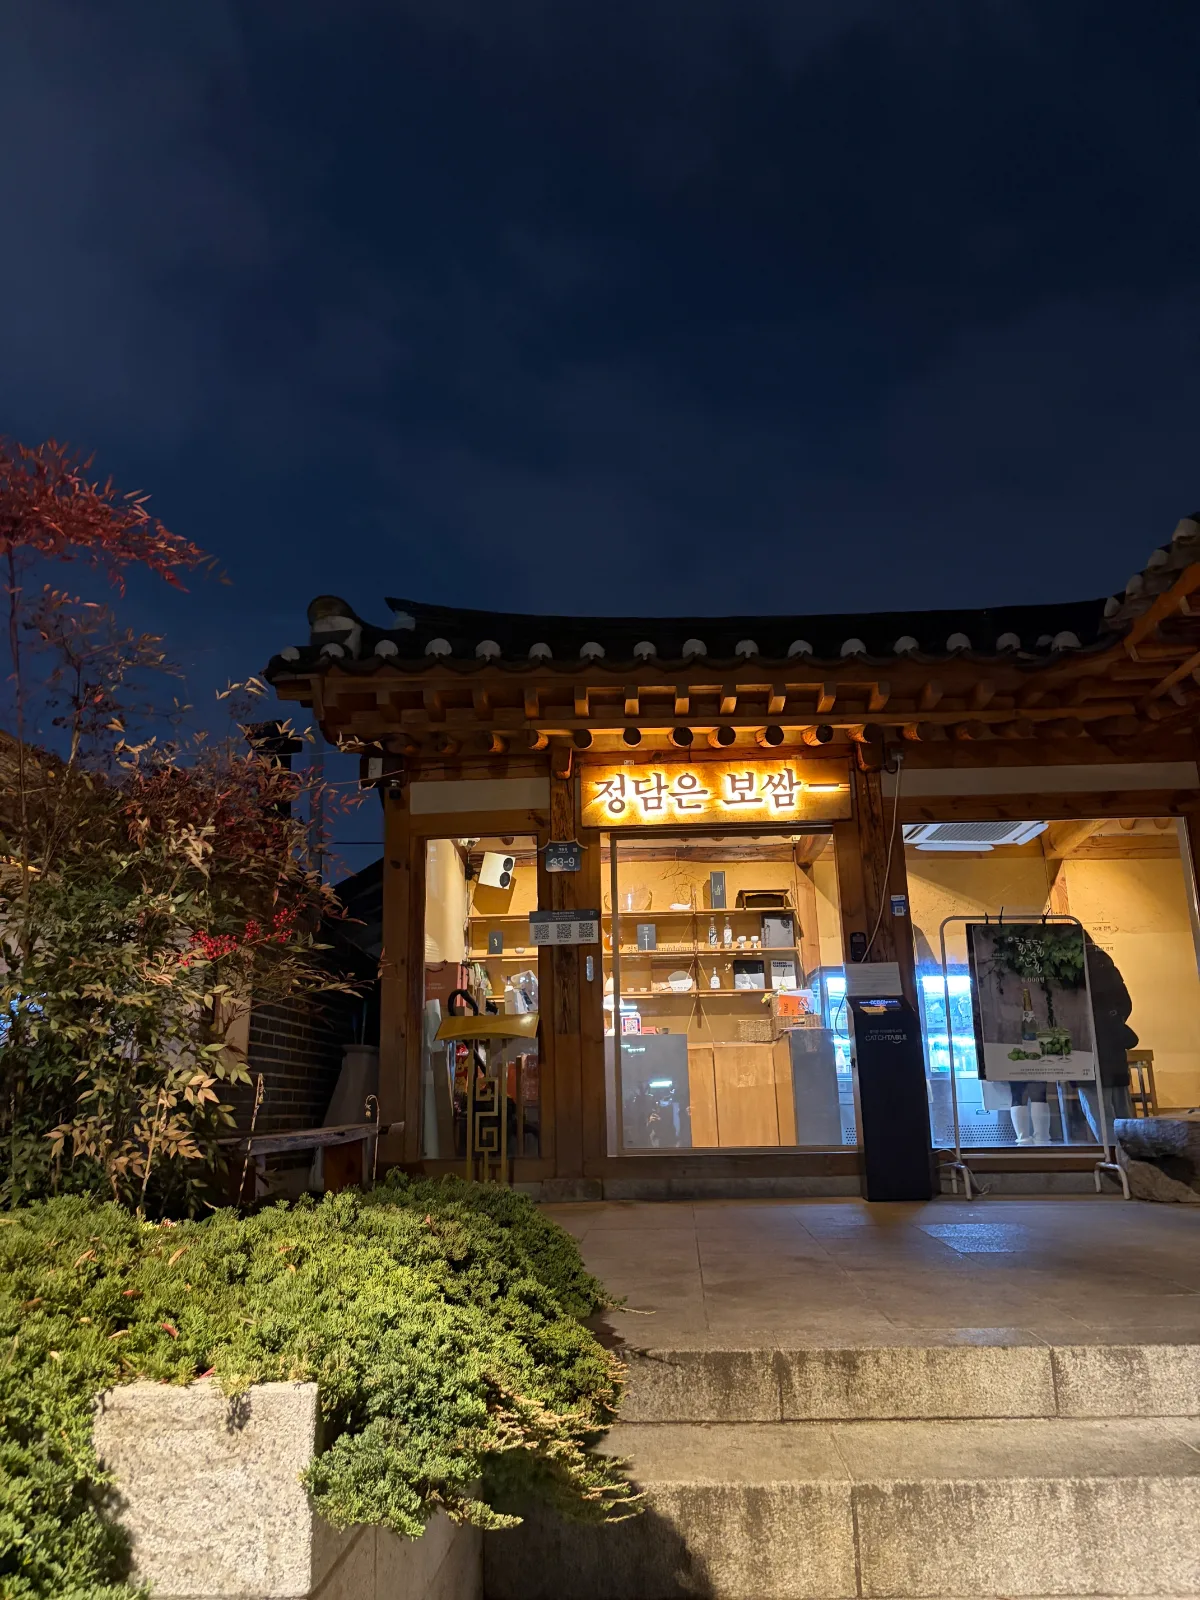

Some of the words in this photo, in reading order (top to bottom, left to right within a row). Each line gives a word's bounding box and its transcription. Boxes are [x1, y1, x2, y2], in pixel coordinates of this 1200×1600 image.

[593, 772, 709, 814] 정담은
[722, 768, 801, 809] 보쌈
[865, 1034, 908, 1042] CATCHTABLE
